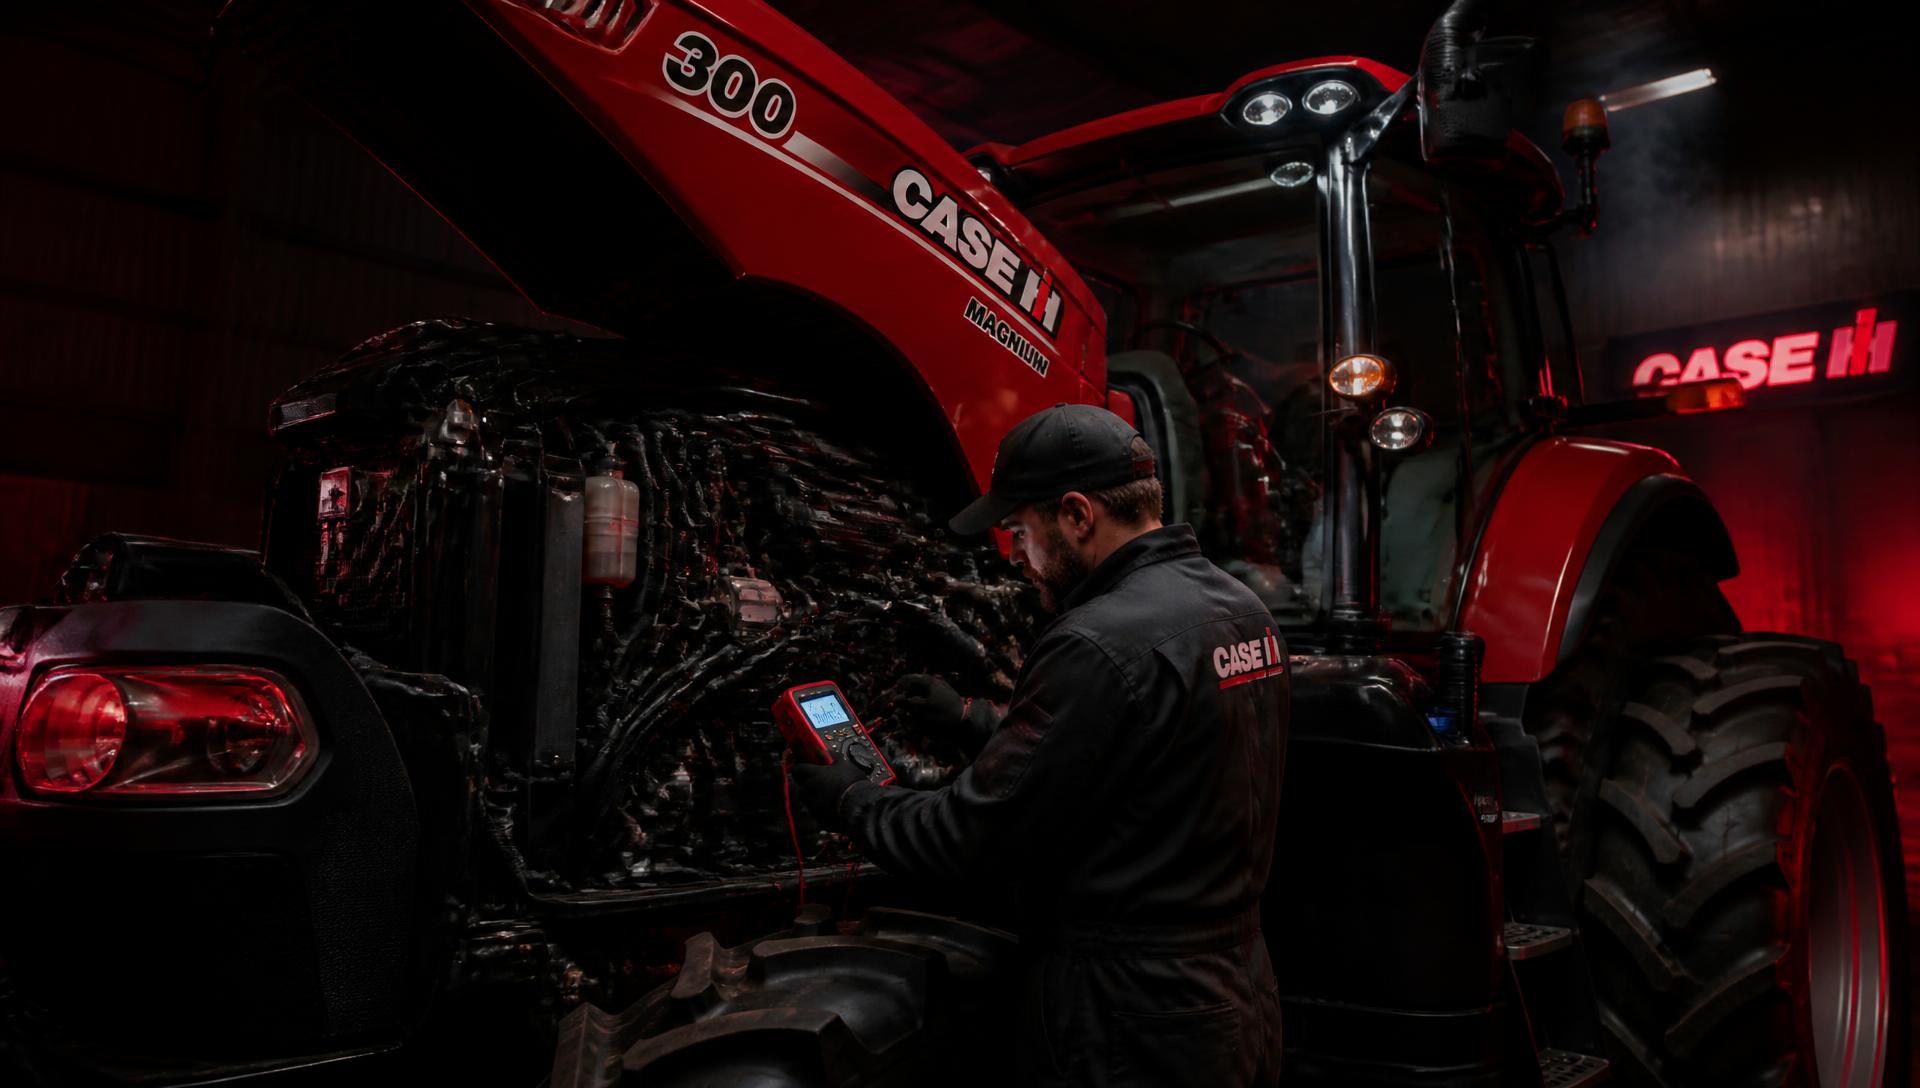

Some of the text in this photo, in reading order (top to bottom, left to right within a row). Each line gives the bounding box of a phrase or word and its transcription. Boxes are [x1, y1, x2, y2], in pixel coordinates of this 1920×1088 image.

[662, 31, 796, 138] 300
[893, 169, 1021, 295] CASE
[1633, 332, 1819, 396] CASE
[1213, 639, 1263, 678] CASE
